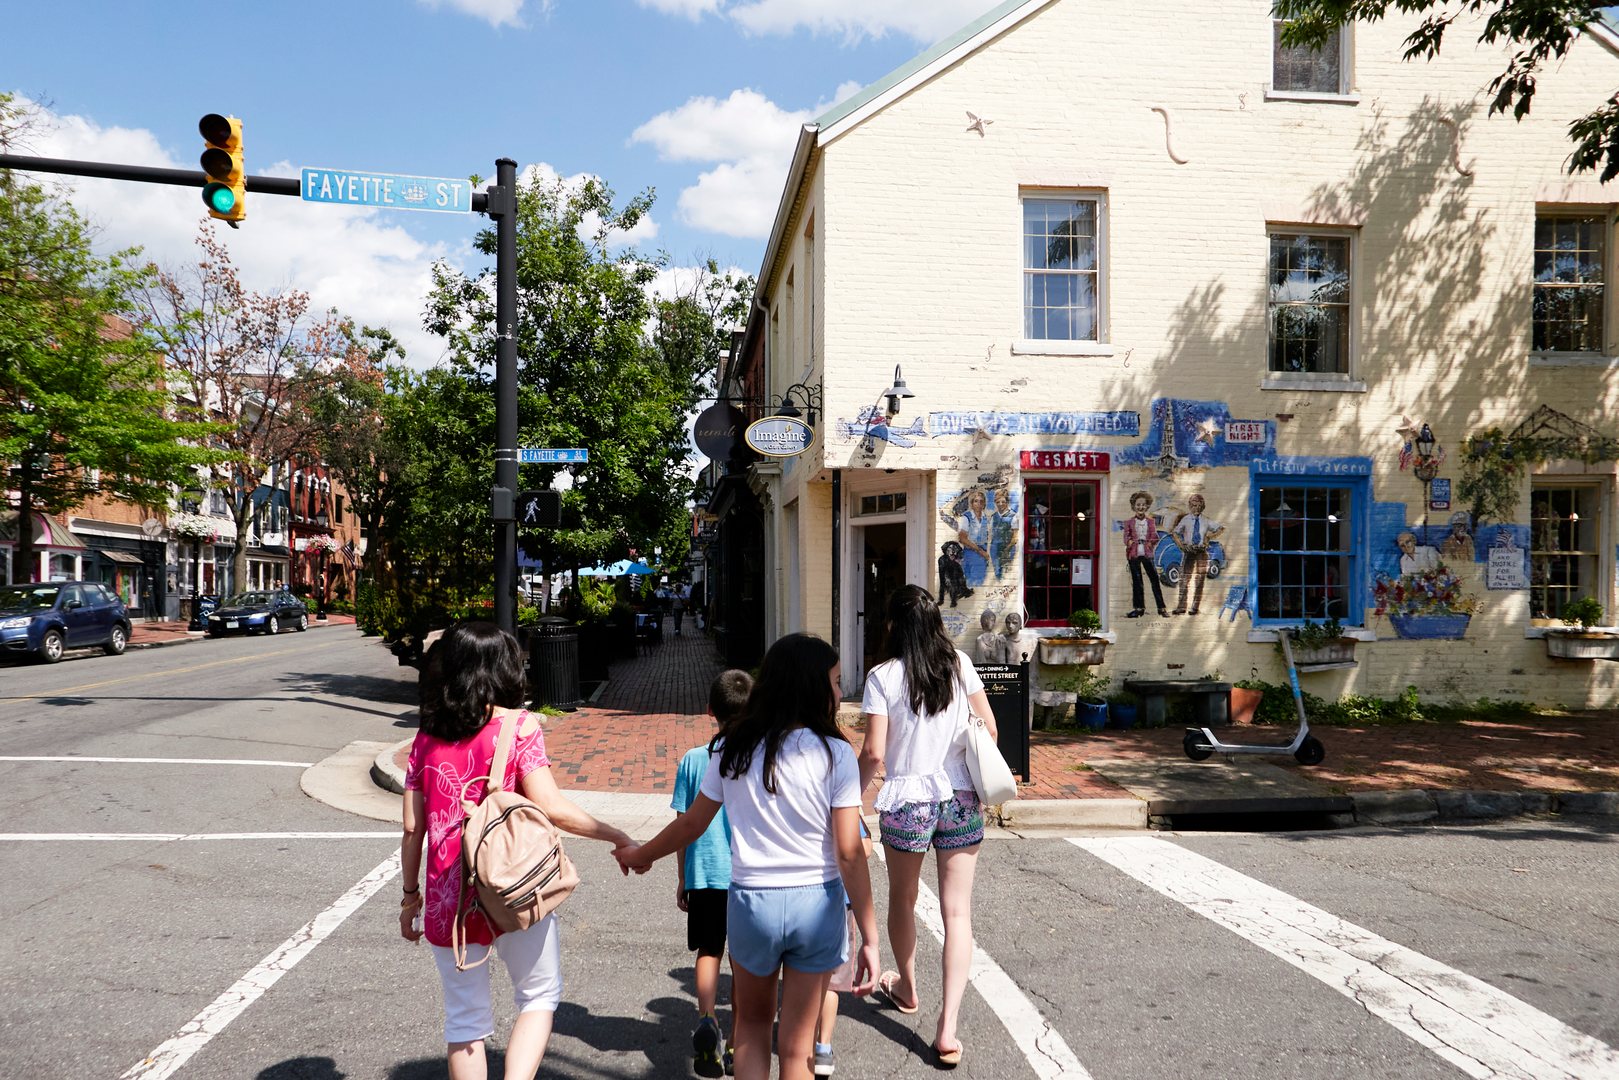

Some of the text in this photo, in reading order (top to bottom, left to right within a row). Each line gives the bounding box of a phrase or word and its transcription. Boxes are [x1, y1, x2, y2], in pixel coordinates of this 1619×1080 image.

[307, 172, 462, 208] FAYETTE ST
[1018, 415, 1041, 433] ALL
[1047, 413, 1077, 434] YOU
[1229, 424, 1260, 432] FIRST
[754, 429, 806, 445] Imagine
[1229, 432, 1261, 440] NIGHT
[523, 451, 528, 461] S
[529, 450, 555, 461] FAYETTE
